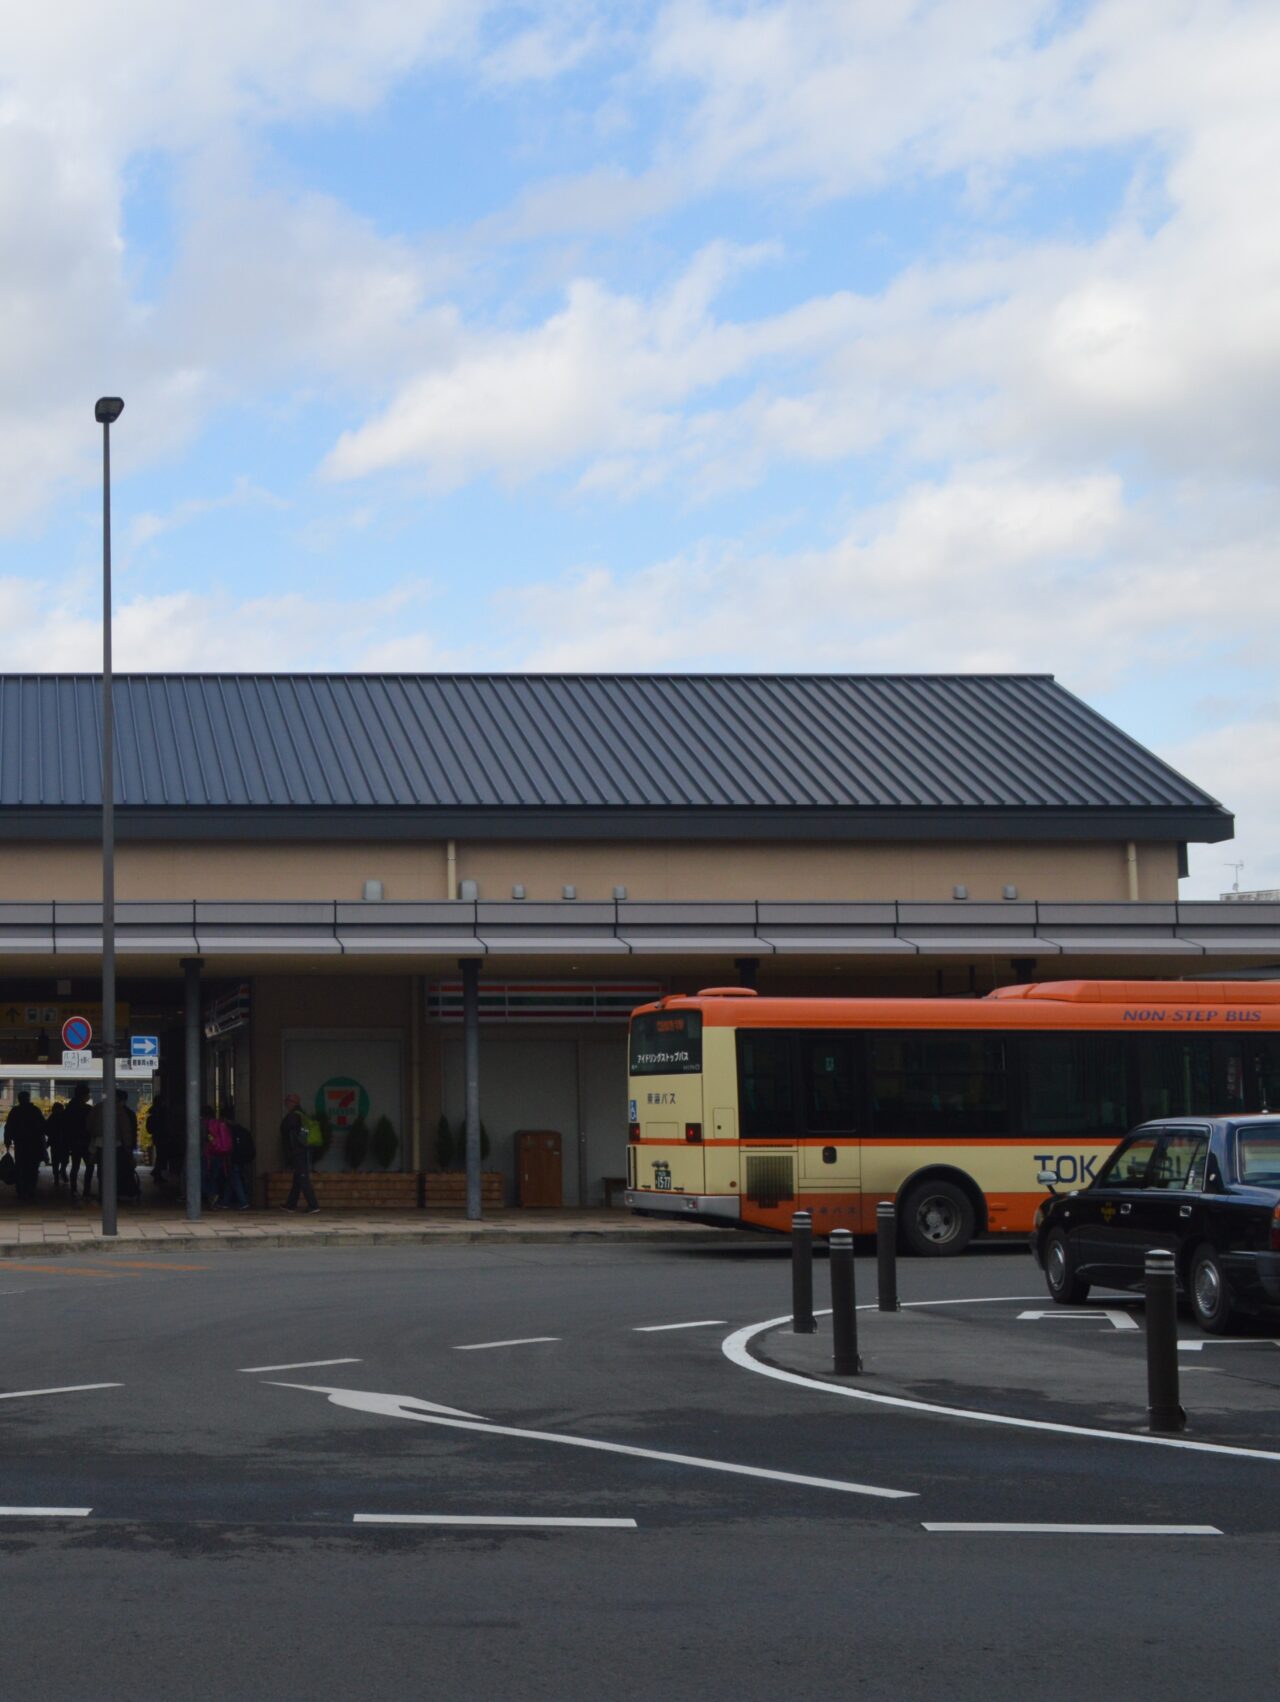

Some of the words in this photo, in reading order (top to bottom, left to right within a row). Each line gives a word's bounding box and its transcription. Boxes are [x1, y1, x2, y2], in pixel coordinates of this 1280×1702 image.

[1122, 1009, 1218, 1022] NON-STEP
[1225, 1009, 1262, 1022] BUS
[637, 1051, 689, 1064] アイドリングストップバス
